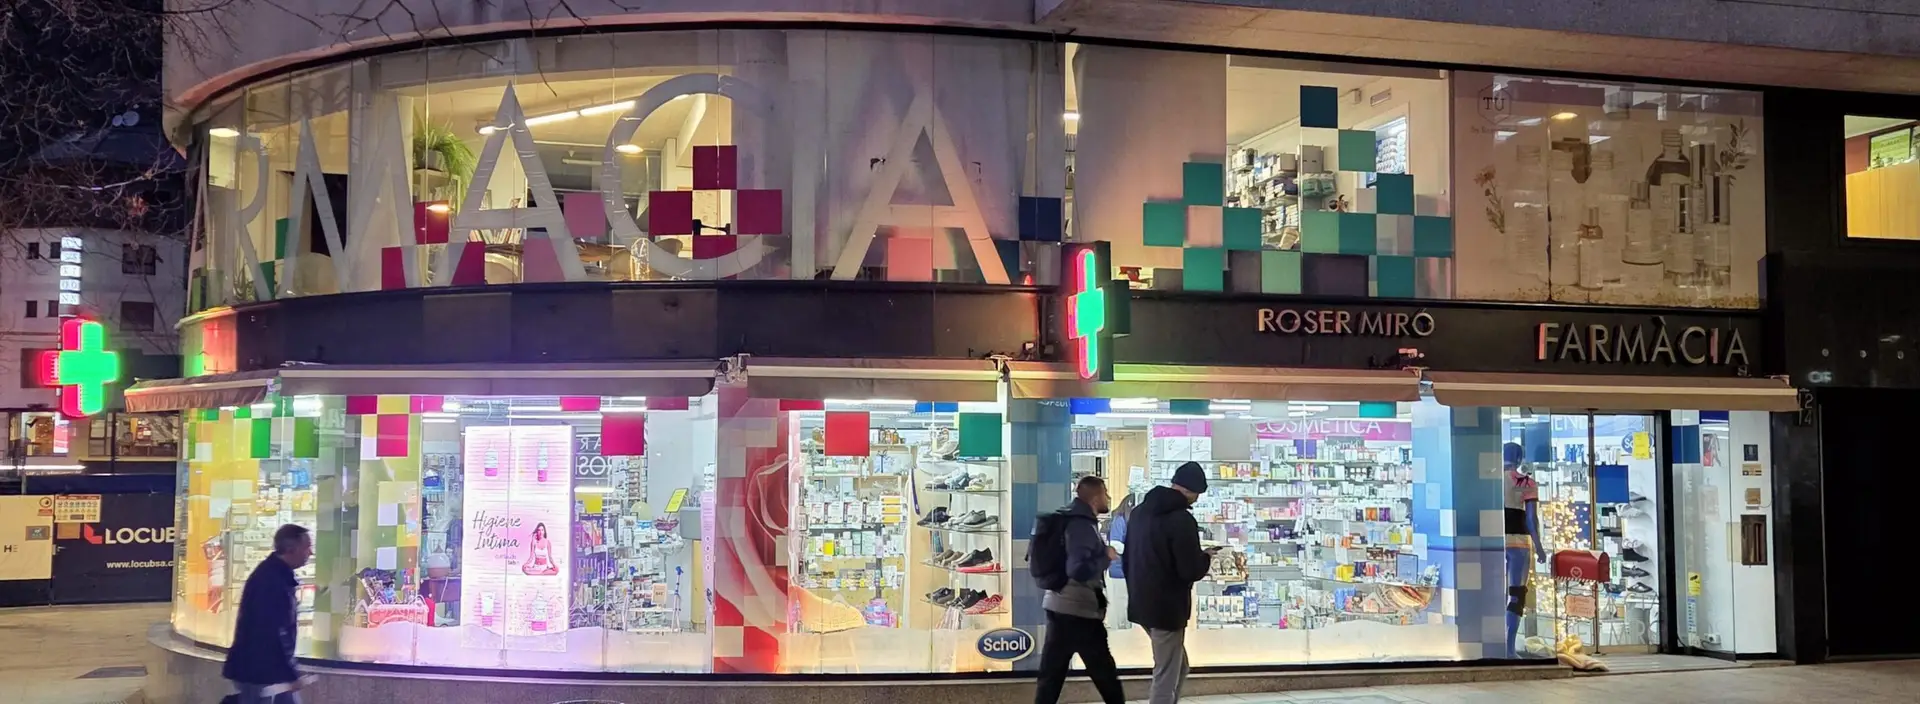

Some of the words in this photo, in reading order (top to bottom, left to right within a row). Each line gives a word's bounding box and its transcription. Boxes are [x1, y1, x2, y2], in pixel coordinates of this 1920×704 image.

[1483, 96, 1505, 112] TU
[1258, 308, 1352, 334] ROSER
[1360, 308, 1435, 336] MIRÓ
[1538, 315, 1749, 364] FARMÀCIA
[472, 510, 522, 536] Higiene
[983, 636, 1027, 652] Scholl
